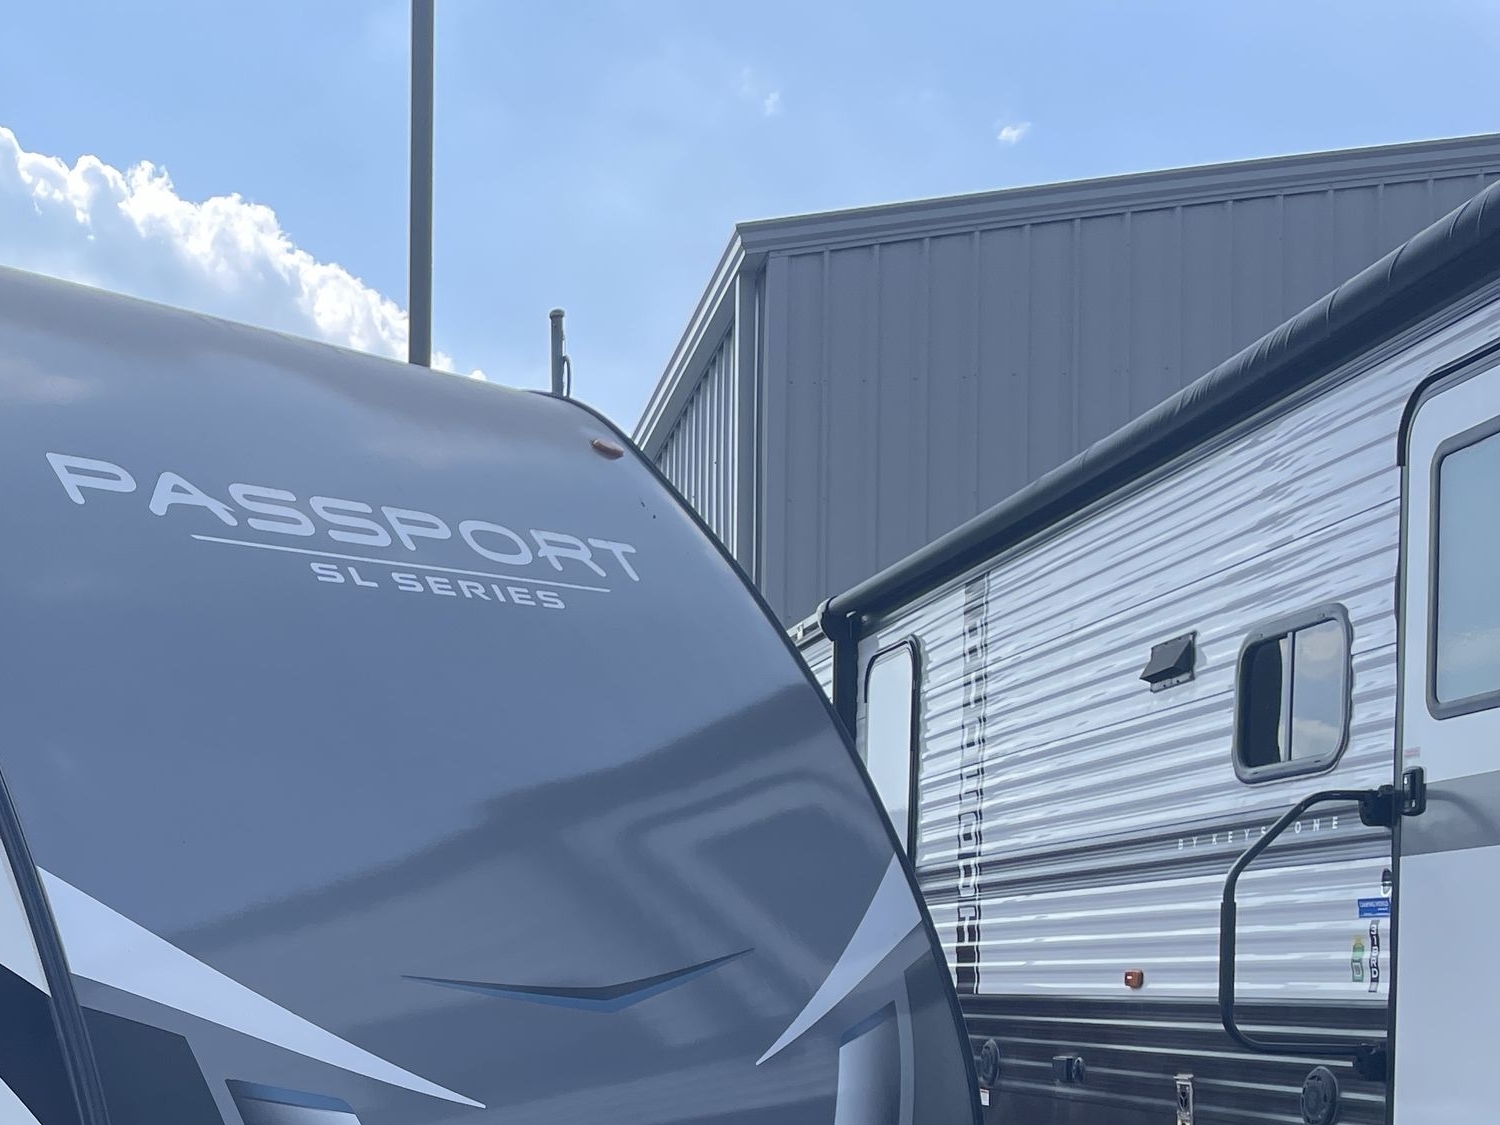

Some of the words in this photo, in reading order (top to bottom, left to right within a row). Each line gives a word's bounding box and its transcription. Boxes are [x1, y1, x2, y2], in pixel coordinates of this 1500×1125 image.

[45, 451, 639, 582] PASSPORT
[309, 562, 379, 588] SL
[391, 571, 566, 610] SERIES
[1177, 836, 1198, 850] BY
[1211, 816, 1339, 845] KEYSONE
